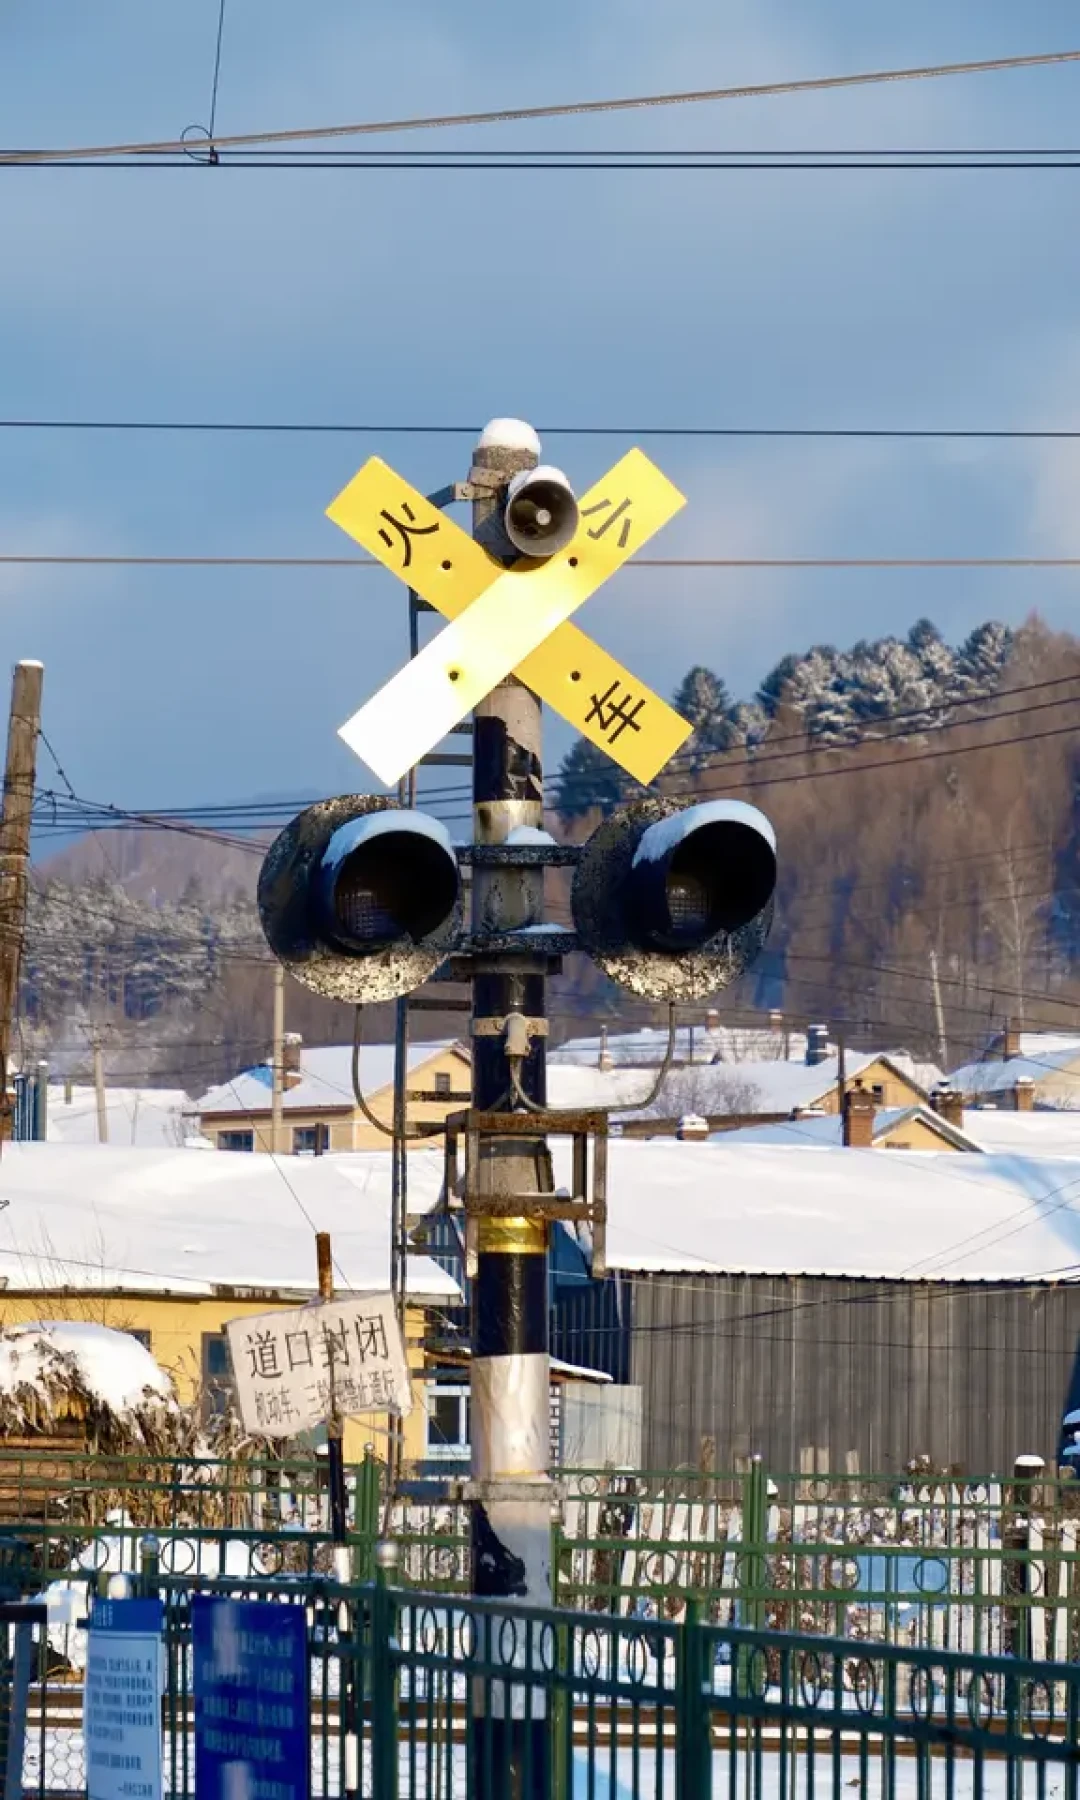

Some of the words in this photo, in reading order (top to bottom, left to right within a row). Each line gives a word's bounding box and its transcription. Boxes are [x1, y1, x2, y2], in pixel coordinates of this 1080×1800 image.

[378, 502, 440, 568] 火
[580, 497, 633, 549] 小
[584, 680, 647, 744] 车
[245, 1313, 389, 1379] 道口封闭
